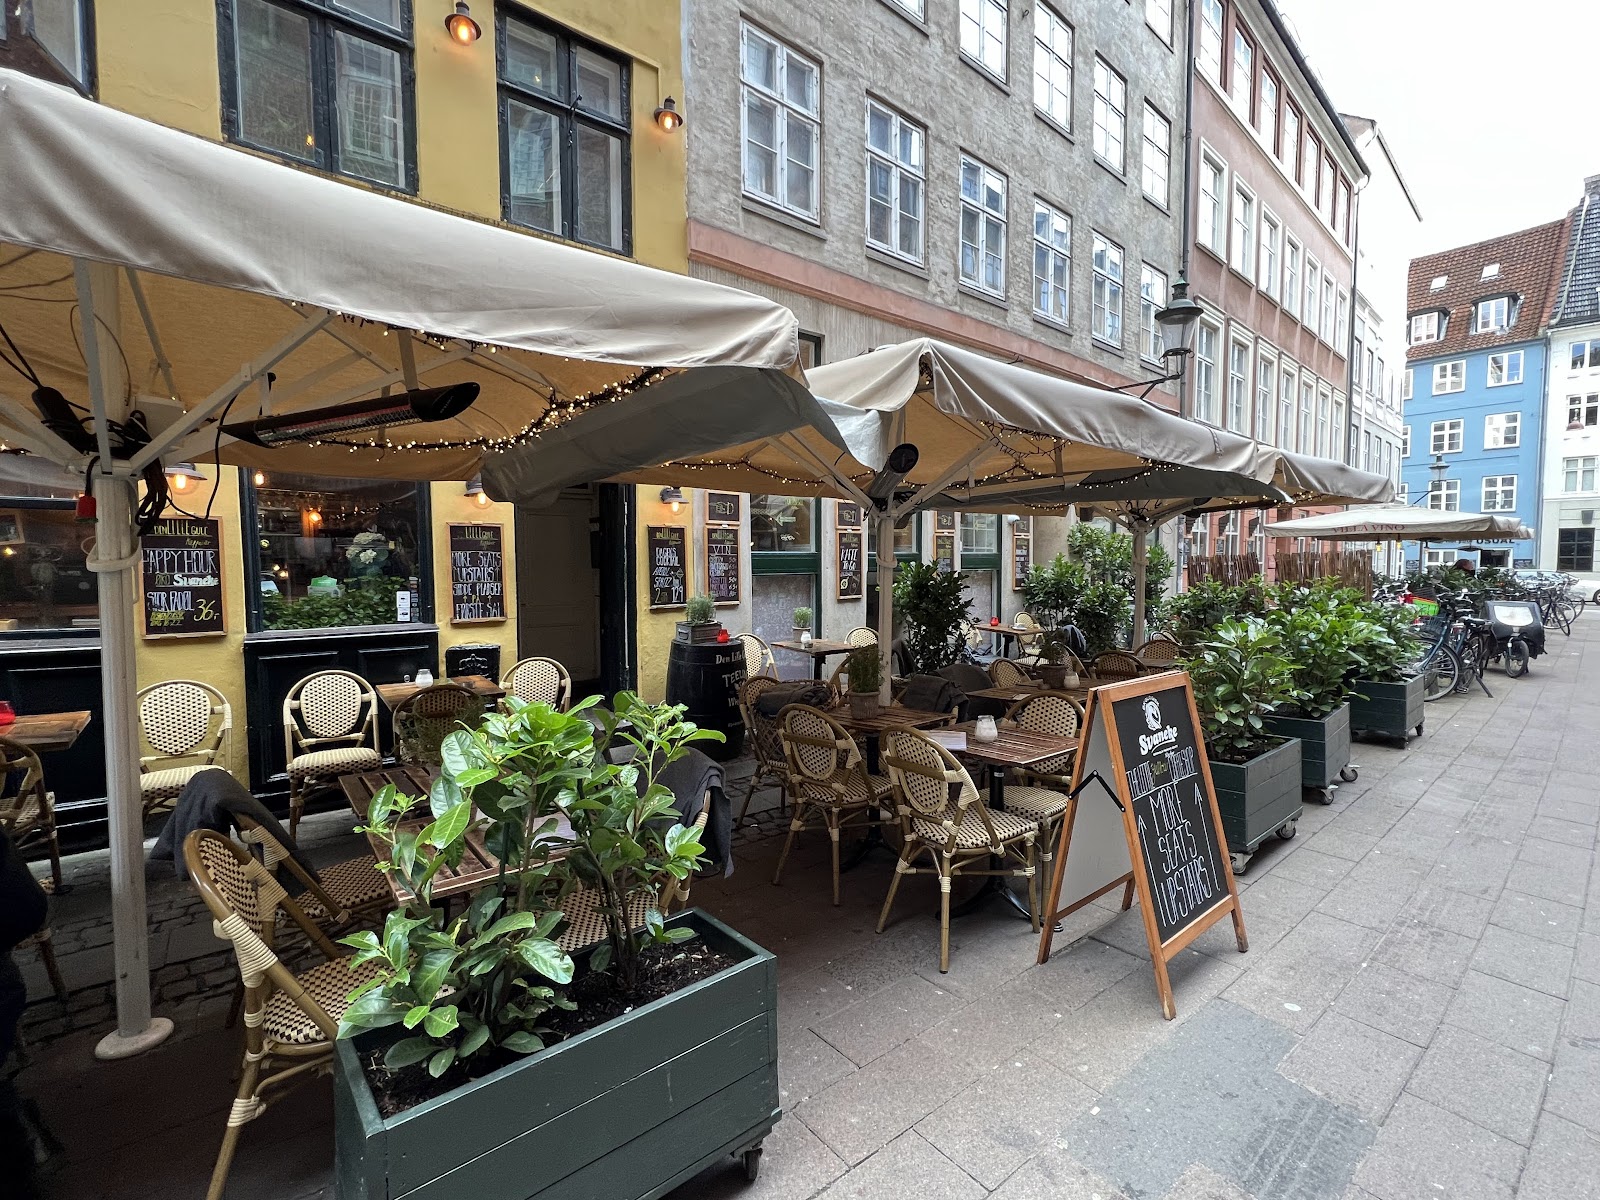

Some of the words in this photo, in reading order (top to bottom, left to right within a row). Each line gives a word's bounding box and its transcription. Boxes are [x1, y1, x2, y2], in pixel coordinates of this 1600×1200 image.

[1332, 524, 1368, 533] VILLA
[142, 549, 181, 574] HAPPY
[184, 550, 219, 574] HOUR
[451, 551, 471, 567] MORE
[477, 551, 502, 567] SEATS
[713, 545, 731, 555] VIN
[457, 566, 495, 583] UPSTAIRS
[1138, 725, 1179, 756] Svaneke
[1149, 780, 1188, 837] MORE
[1157, 820, 1198, 874] SEATS
[1160, 855, 1213, 925] UPSTAIRS
